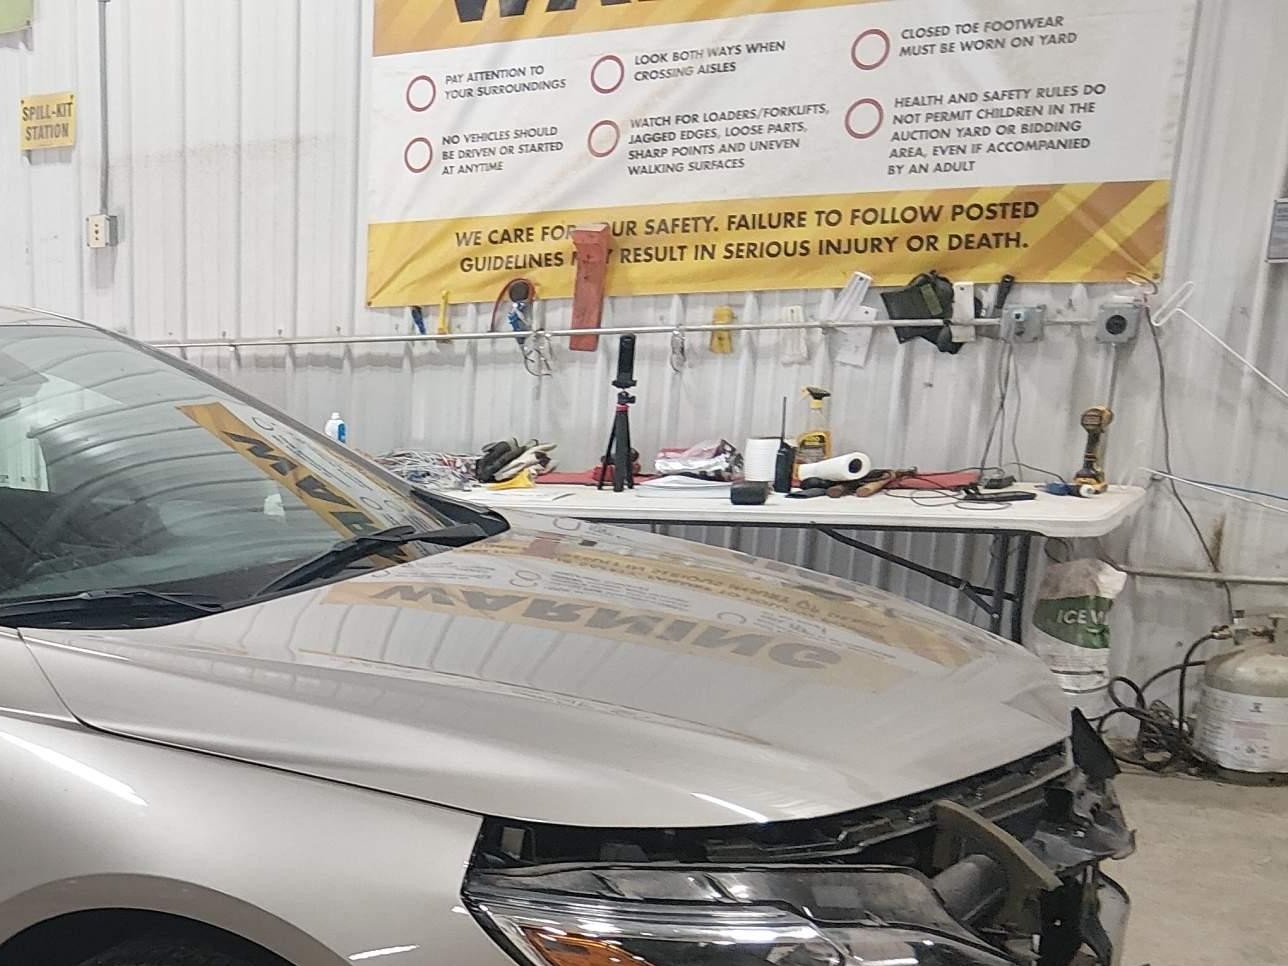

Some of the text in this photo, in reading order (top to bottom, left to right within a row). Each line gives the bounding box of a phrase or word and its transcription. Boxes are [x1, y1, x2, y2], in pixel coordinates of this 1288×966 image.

[901, 15, 1064, 39] CLOSED TOE FOOTWEAR
[635, 40, 786, 65] LOOK BOTH WAYS WHEN
[899, 32, 1078, 57] MUST BE WORN ON YARD
[445, 65, 544, 84] PAY ATTENTION TO
[634, 61, 737, 81] CROSSING AISLES
[445, 79, 567, 99] YOUR SURROUNDINGS
[894, 83, 1106, 108] HEALTH AND SAFETY RULES DO
[22, 102, 73, 121] SPILL-KIT
[631, 103, 830, 129] WATCH FOR LOADERS/FORKLIFTS,
[893, 102, 1096, 125] NOT PERMIT CHILDREN IN THE
[25, 122, 69, 141] STATION
[442, 126, 558, 145] NO VEHICLES SHOULD
[628, 121, 808, 145] JAGGED EDGES, LOOSE PARTS,
[891, 120, 1082, 142] AUCTION YARD OR BIDDING
[442, 141, 563, 160] BE DRIVEN OR STARTED
[628, 138, 800, 160] SHARP POINTS AND UNEVEN
[889, 138, 1090, 159] AREA, EVEN IF ACCOMPANIED
[442, 161, 504, 175] AT ANYTIME
[628, 158, 745, 176] WALKING SURFACES
[888, 160, 976, 176] BY AN ADULT
[455, 230, 482, 247] WE
[487, 226, 534, 245] CARE
[643, 215, 719, 235] SAFETY.
[727, 210, 807, 230] FAILURE
[815, 208, 842, 227] TO
[850, 204, 944, 226] FOLLOW
[951, 201, 1040, 221] POSTED
[459, 252, 564, 273] GUIDELINES
[620, 245, 688, 264] RESULT
[694, 244, 716, 261] IN
[723, 239, 810, 260] SERIOUS
[818, 236, 898, 256] INJURY
[906, 234, 938, 252] OR
[948, 231, 1029, 251] DEATH.
[1056, 609, 1088, 625] ICE
